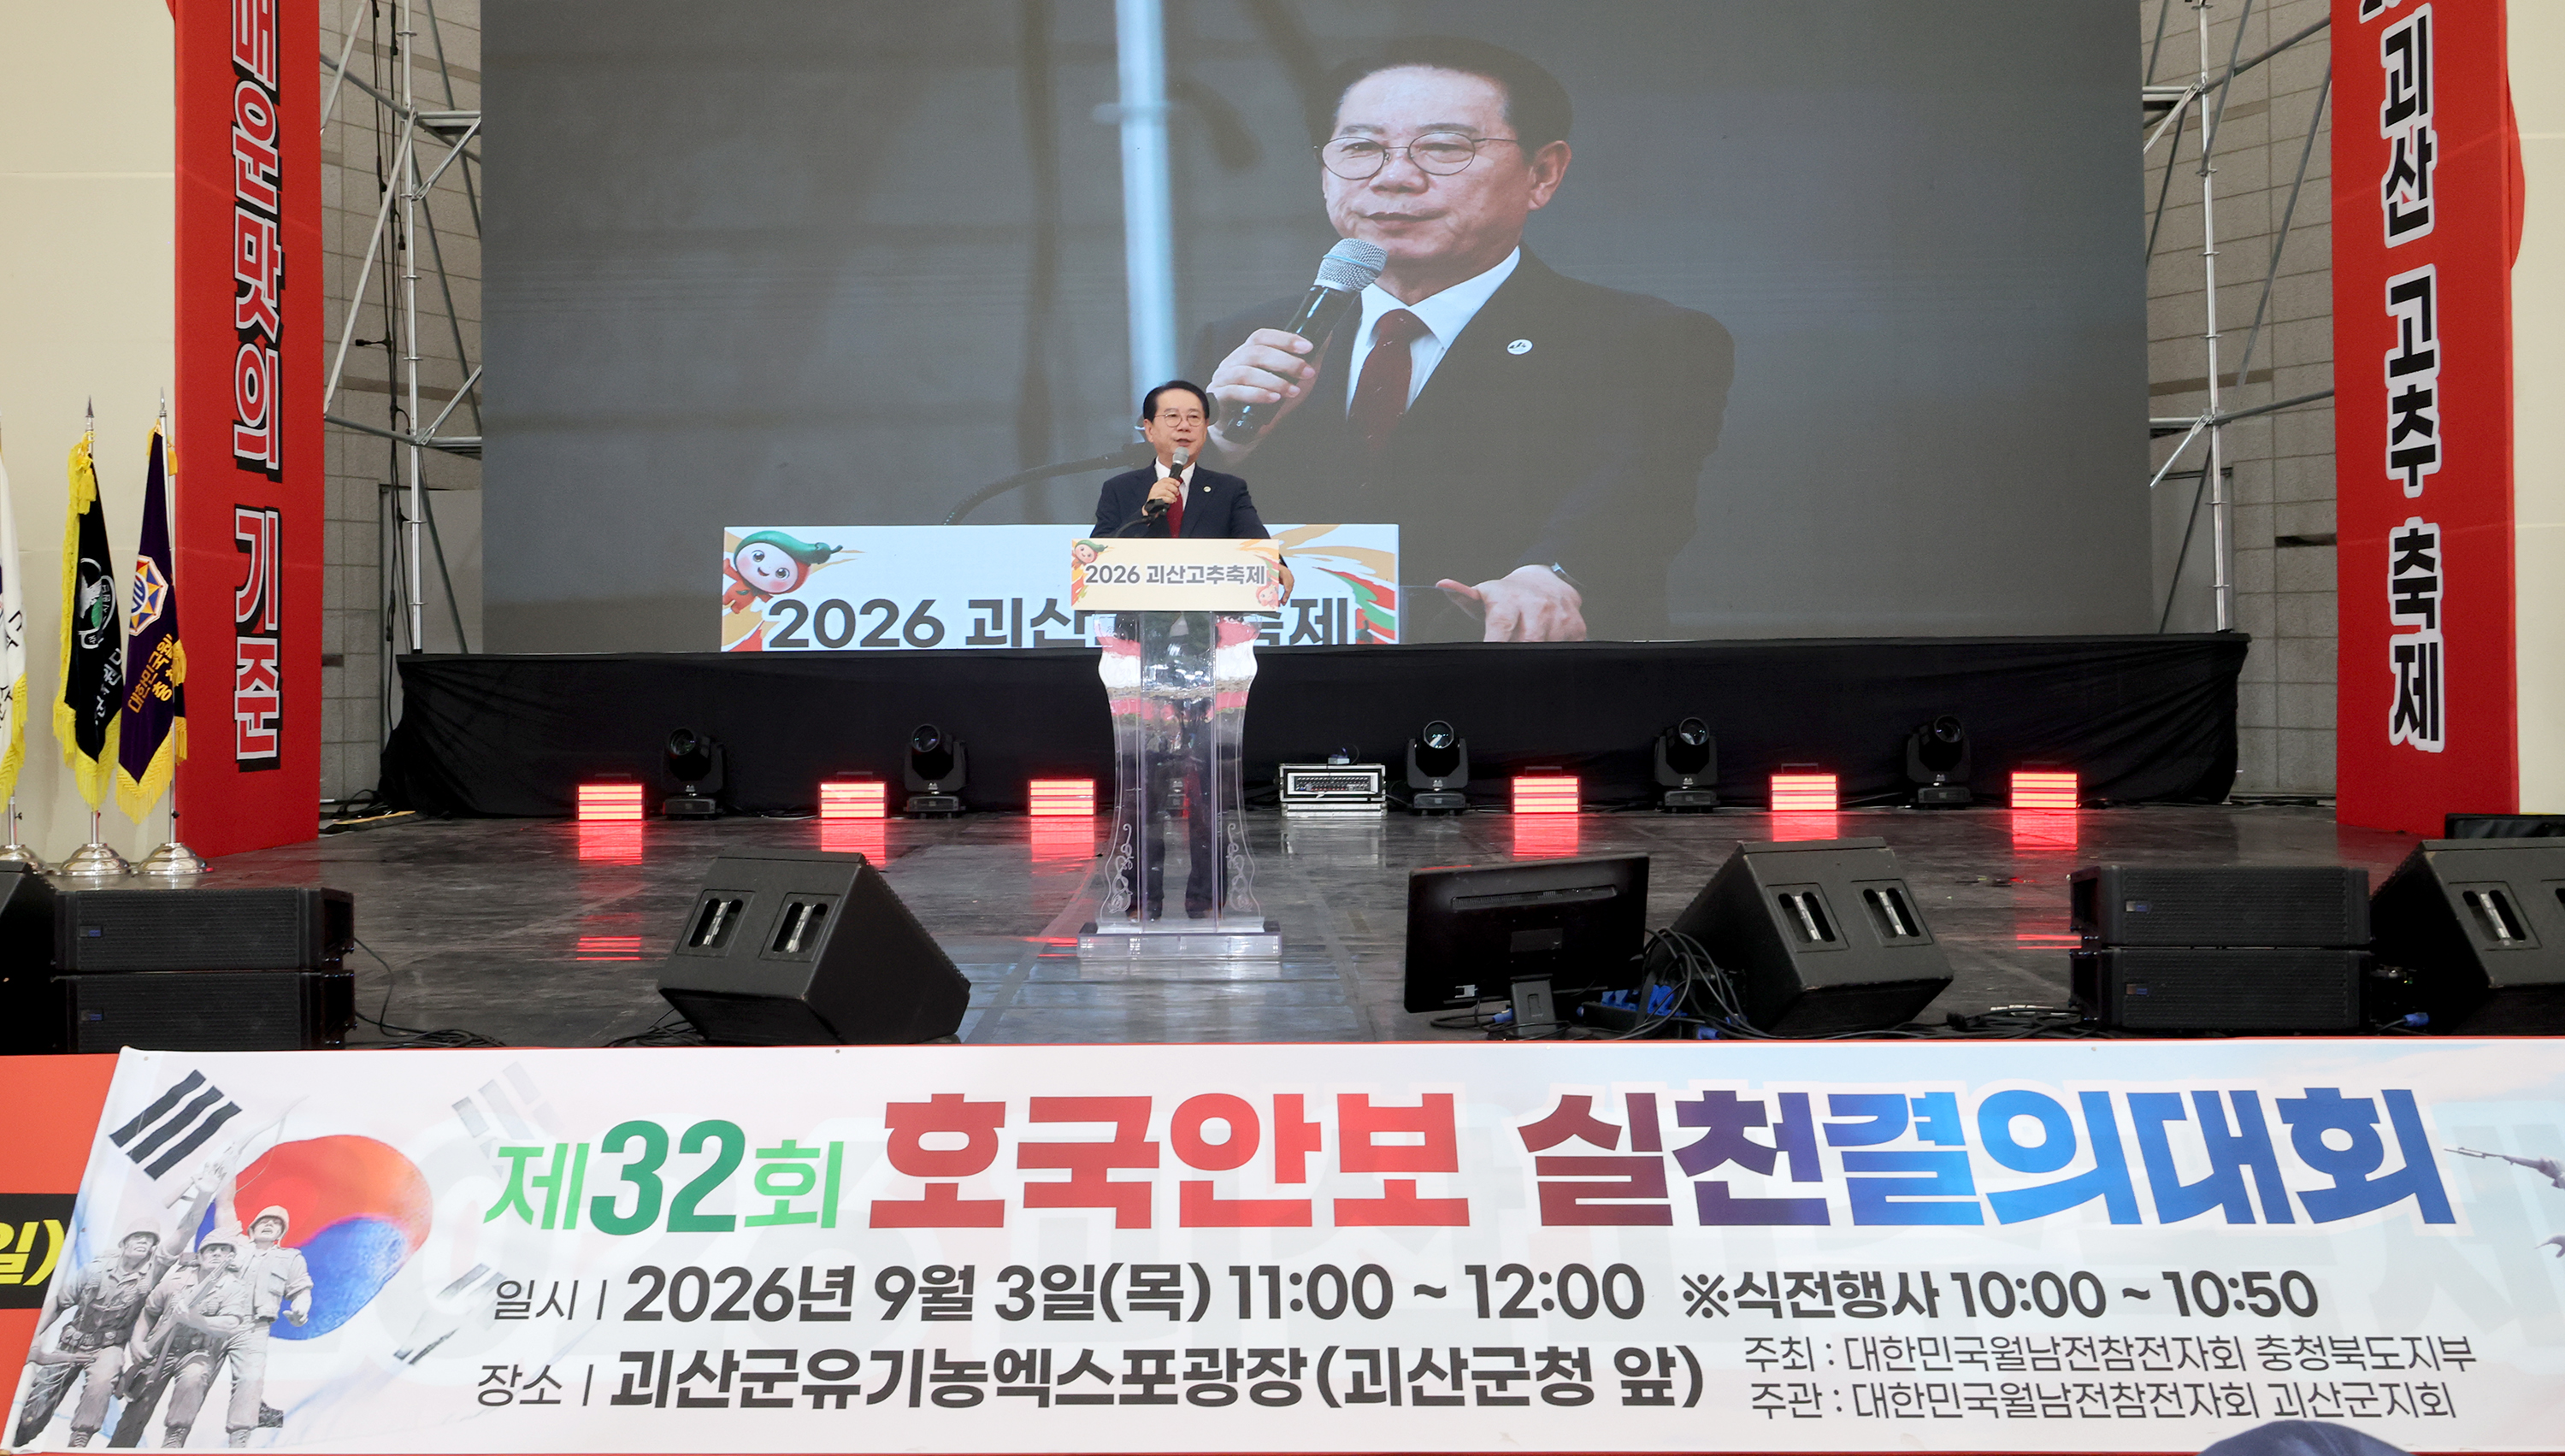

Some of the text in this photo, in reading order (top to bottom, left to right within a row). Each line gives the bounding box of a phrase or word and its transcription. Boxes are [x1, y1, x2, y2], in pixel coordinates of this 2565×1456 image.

[2382, 12, 2442, 746] 괴산 고추 축제
[1085, 564, 1265, 585] 2026 괴산고추축제
[234, 506, 280, 761] 기준
[769, 598, 945, 648] 2026
[486, 1088, 2456, 1235] 제32회 호국안보 실천결의대회
[494, 1279, 578, 1321] 일시
[624, 1265, 855, 1322] 2026년
[875, 1265, 976, 1322] 9월
[994, 1263, 1211, 1322] 3일(목)
[1229, 1264, 1394, 1320] 11:00
[1465, 1264, 1645, 1320] 12:00
[1950, 1270, 2107, 1318] 10:00
[2161, 1270, 2319, 1318] 10:50
[478, 1363, 563, 1406] 장소
[1613, 1345, 1703, 1408] 앞)
[1744, 1335, 1815, 1373] 주최
[1844, 1335, 2247, 1372] 대한민국월남전참전자회
[2255, 1335, 2477, 1372] 충청북도지부
[1751, 1382, 1823, 1420] 주관
[1852, 1382, 2260, 1419] 대한민국월남전참전자회
[2273, 1382, 2456, 1419] 괴산군지회
